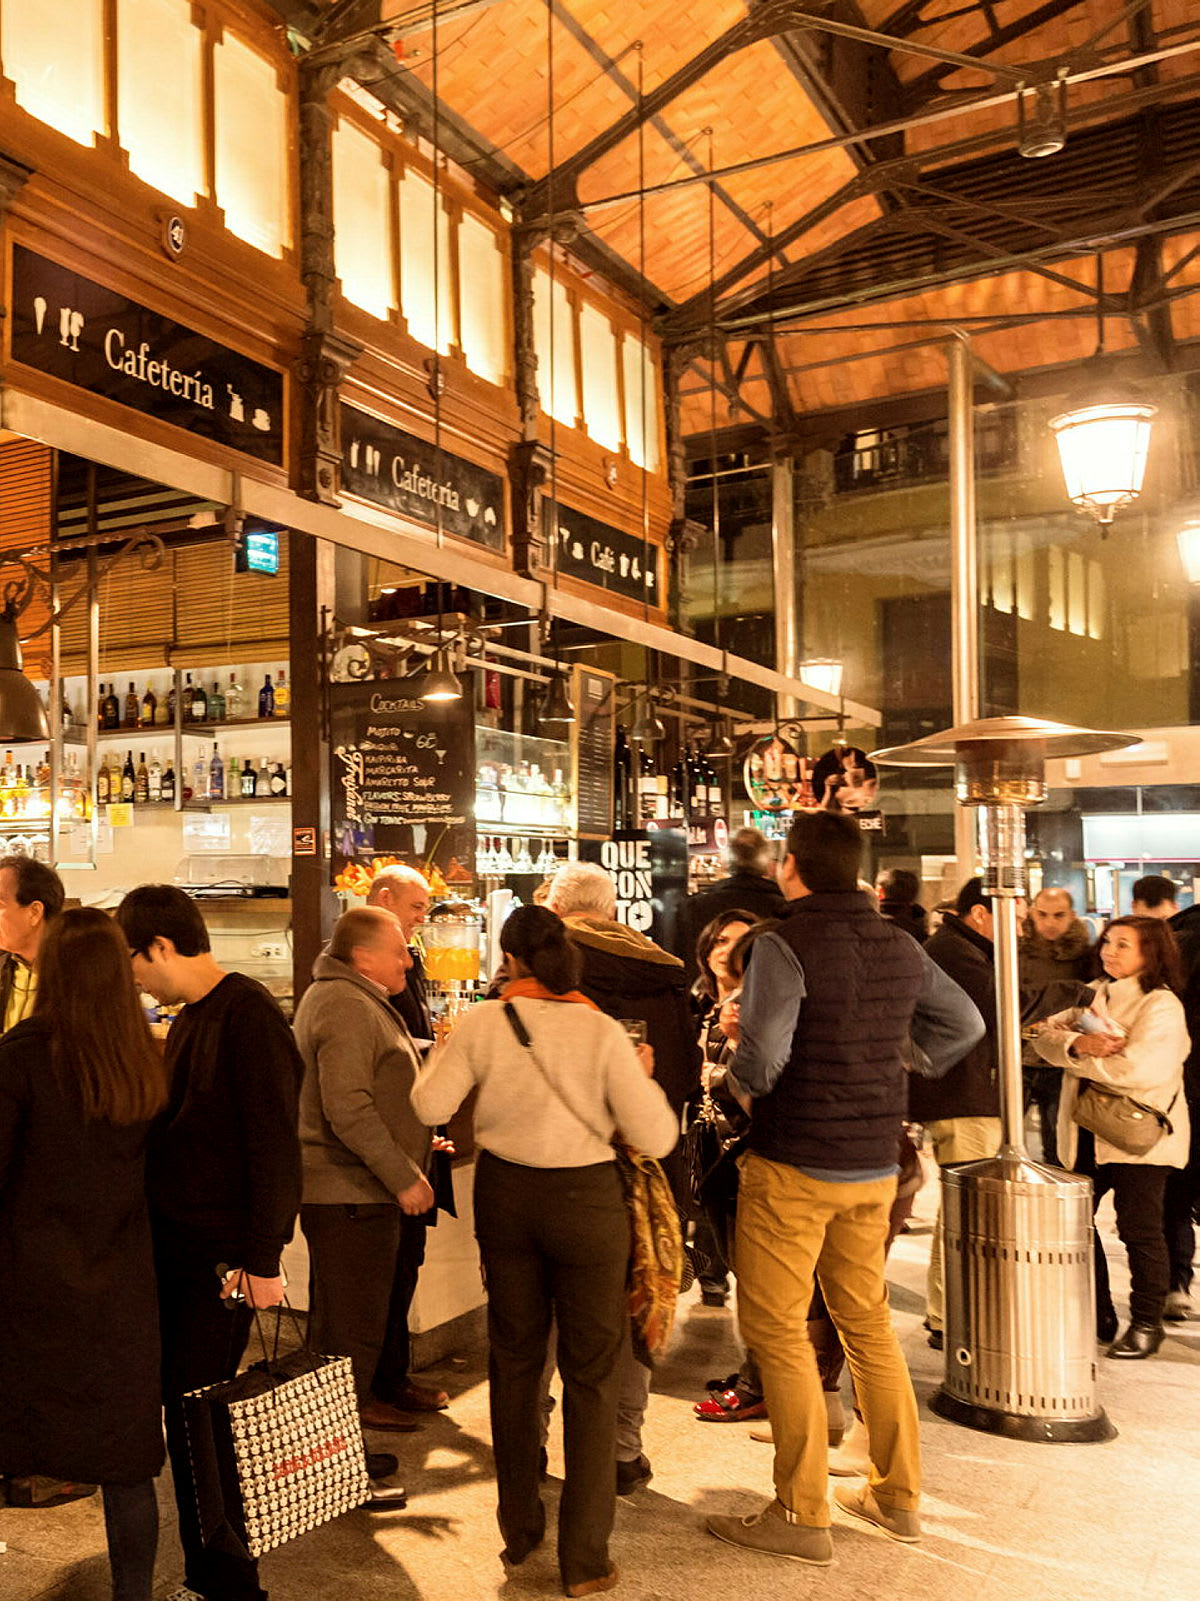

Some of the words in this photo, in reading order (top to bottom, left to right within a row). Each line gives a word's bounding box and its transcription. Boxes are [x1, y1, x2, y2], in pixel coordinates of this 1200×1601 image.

[104, 328, 215, 409] Cafetería
[392, 456, 460, 512] Cafetería
[601, 840, 652, 870] QUE
[613, 870, 653, 899] ON
